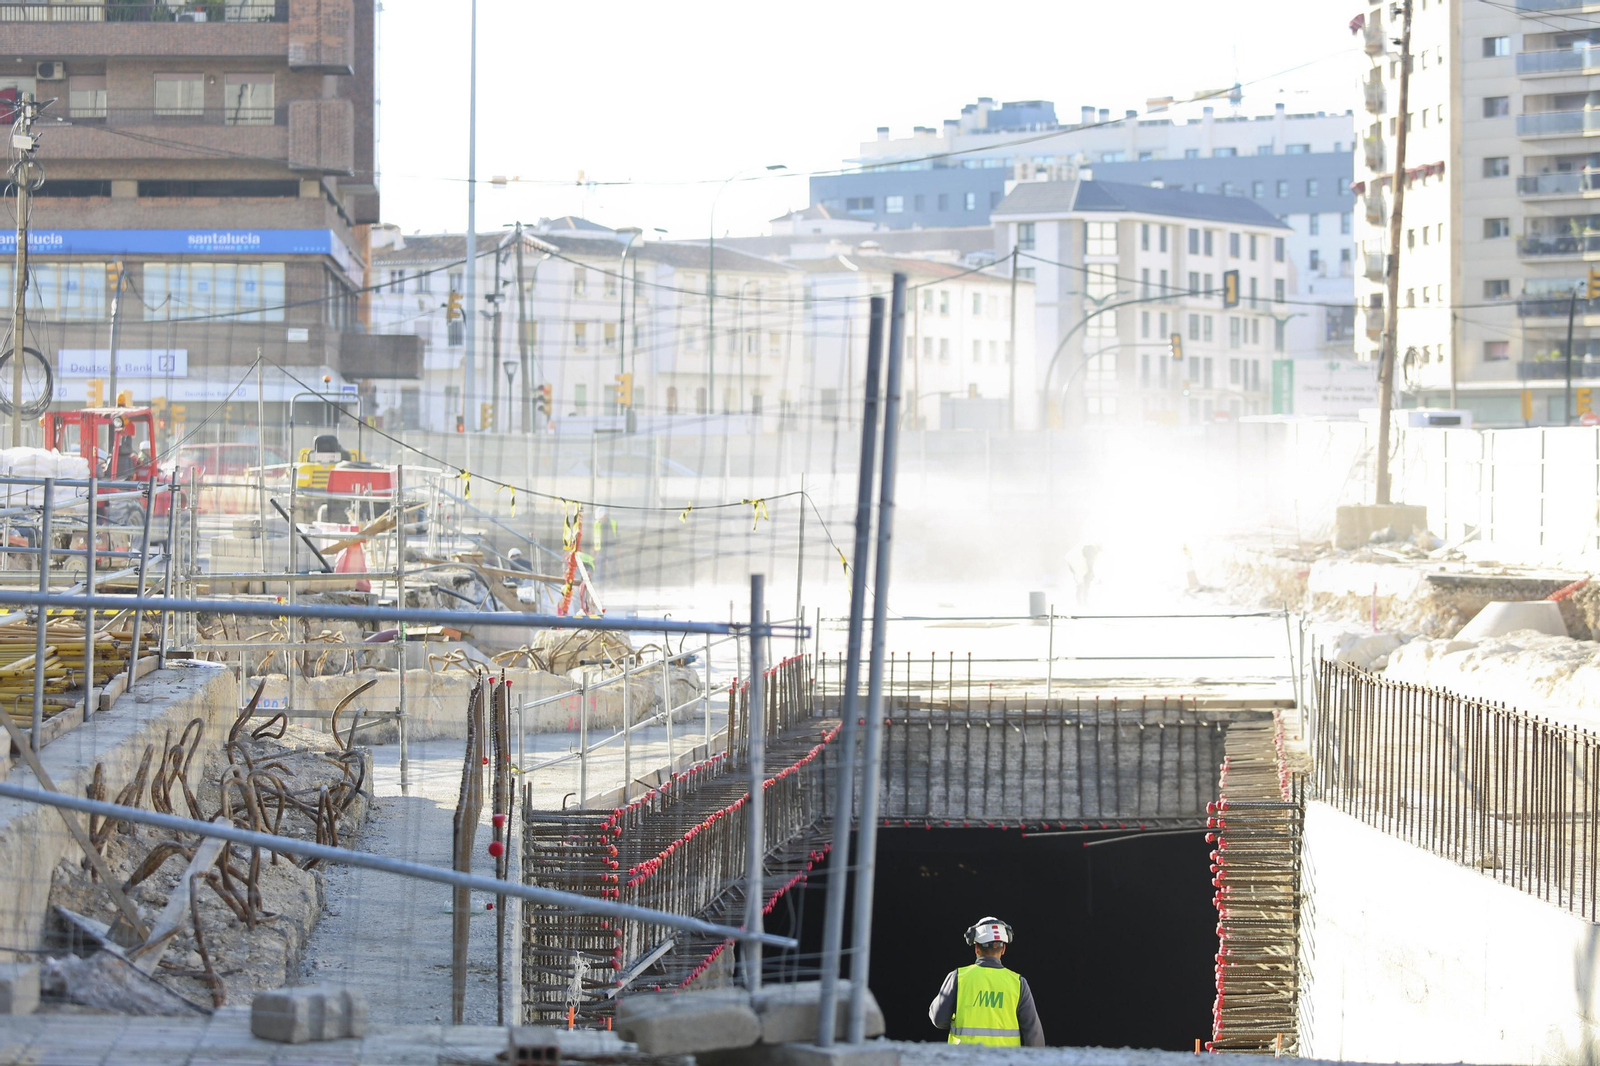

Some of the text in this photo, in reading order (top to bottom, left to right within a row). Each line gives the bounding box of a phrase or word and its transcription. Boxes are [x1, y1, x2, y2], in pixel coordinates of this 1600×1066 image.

[0, 233, 63, 245] anlucía
[188, 233, 260, 244] santalucía
[70, 363, 152, 373] Deutsce Bank
